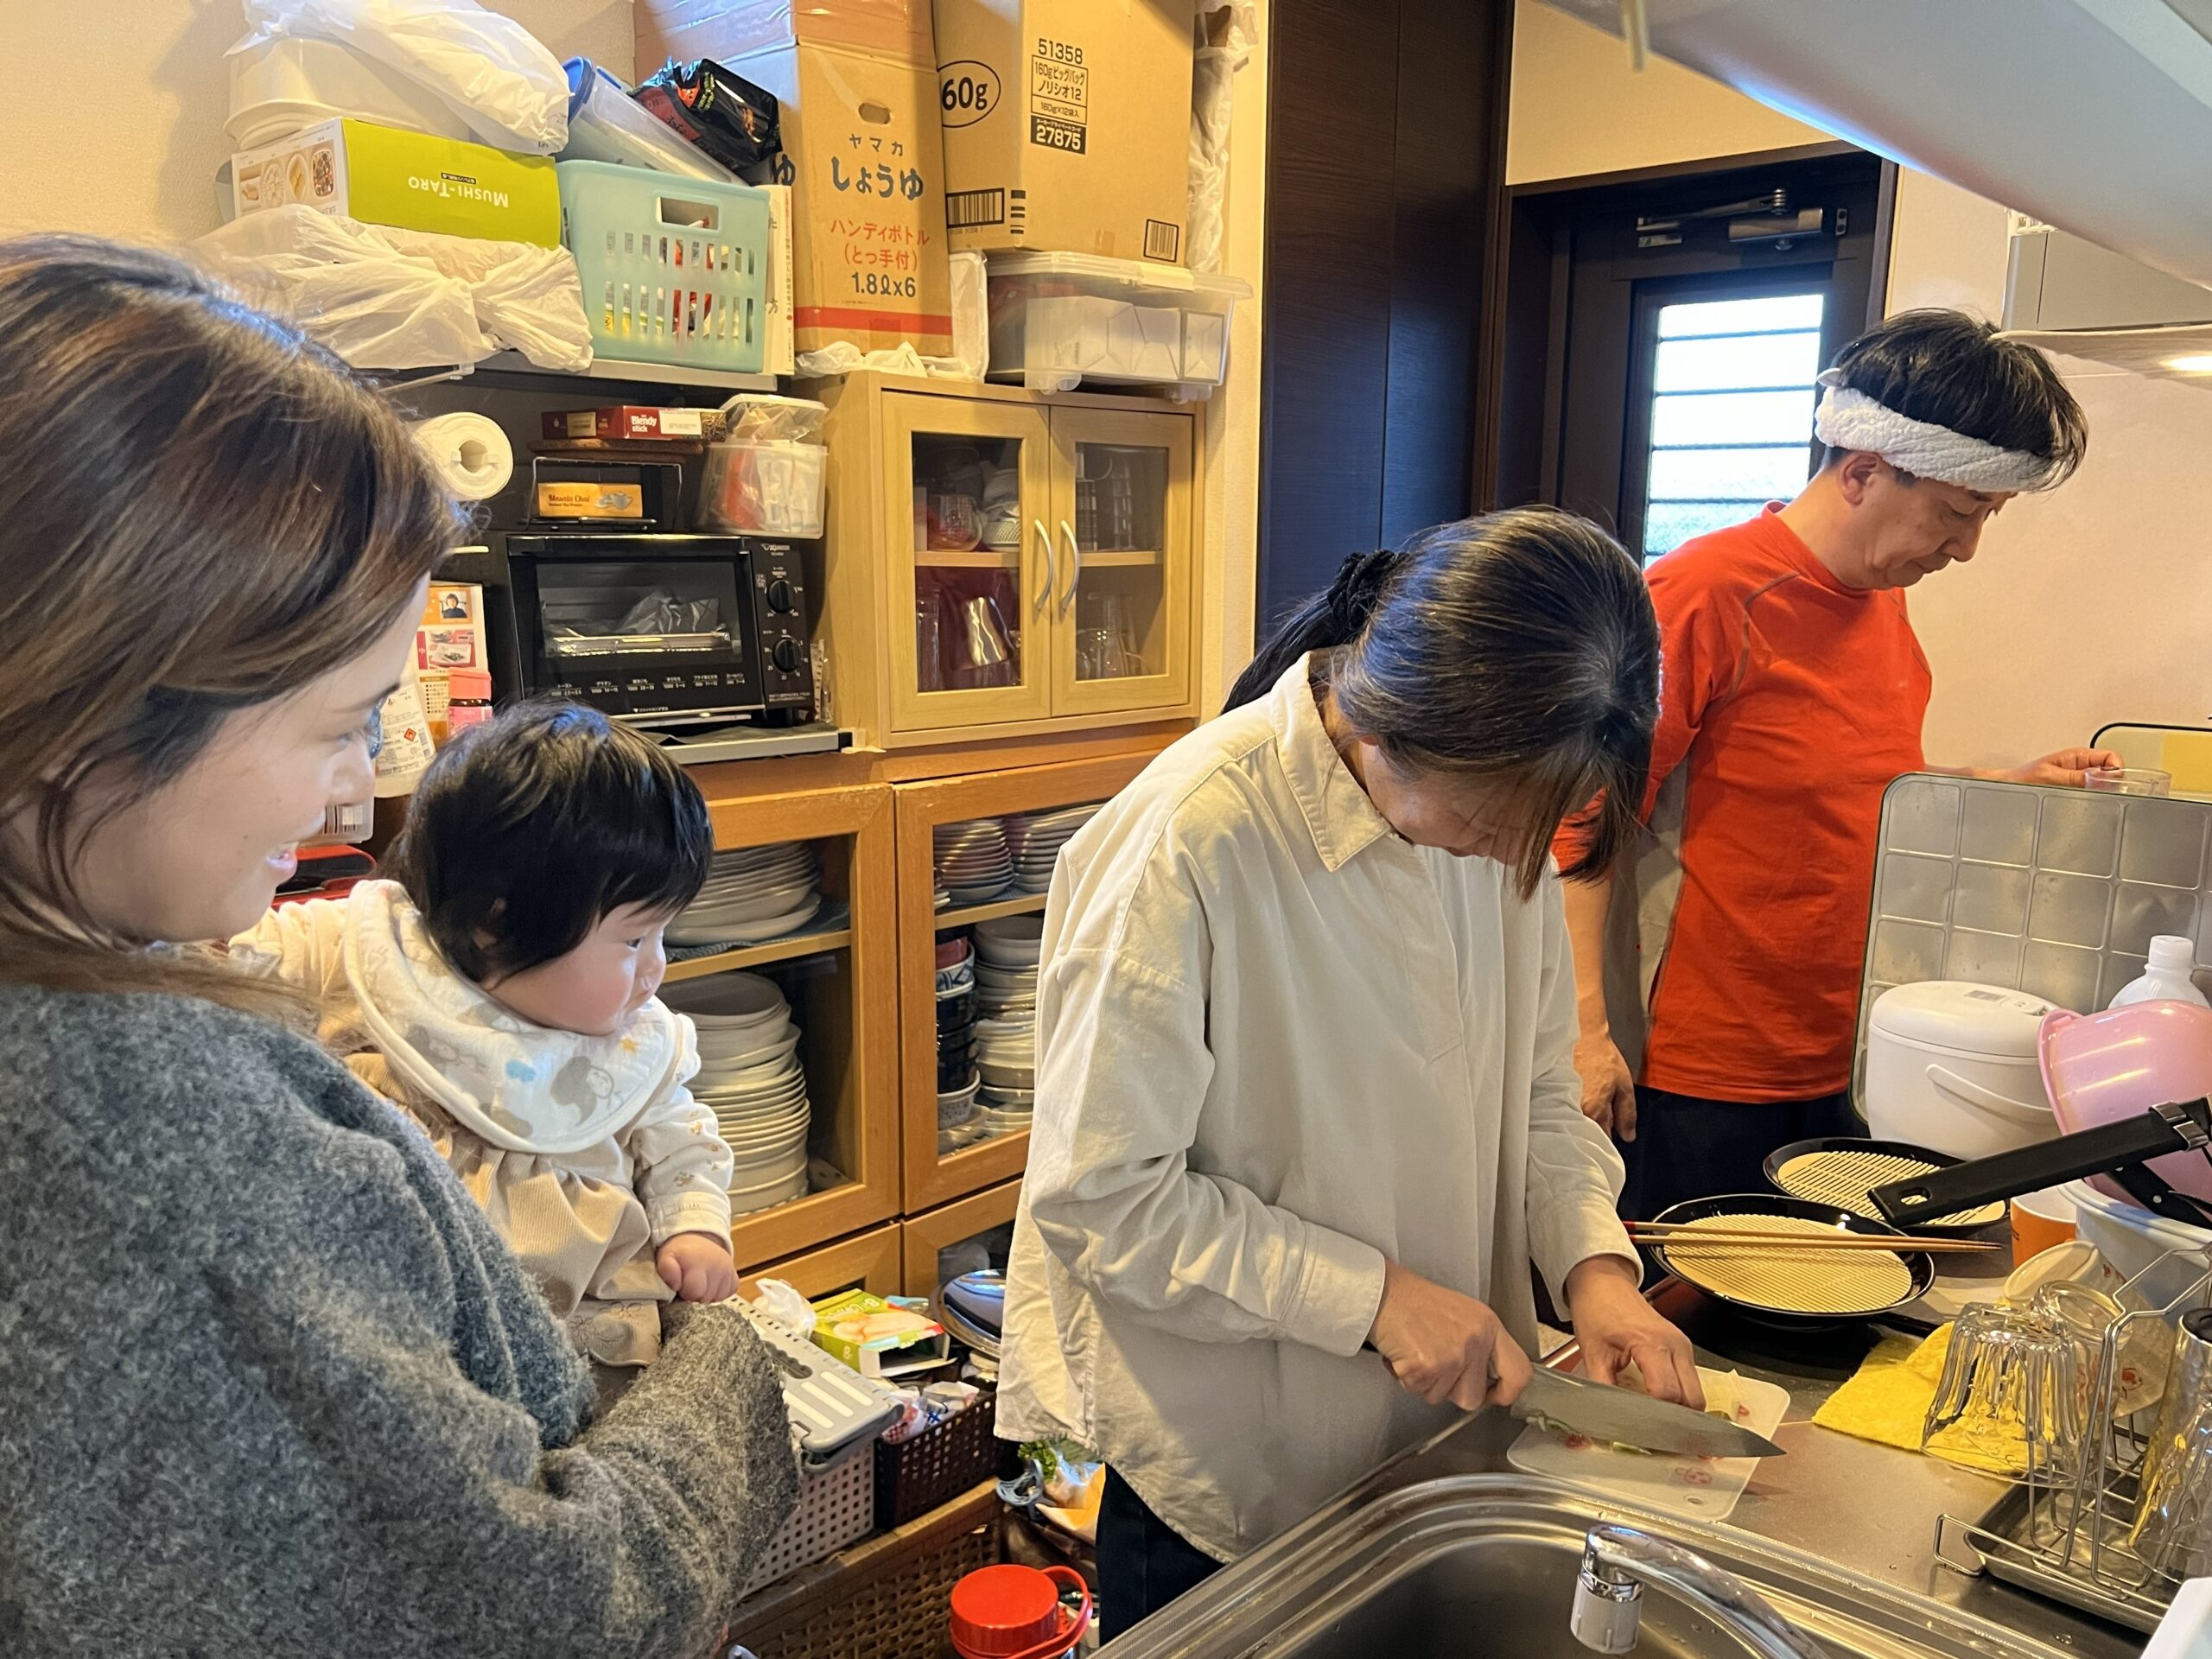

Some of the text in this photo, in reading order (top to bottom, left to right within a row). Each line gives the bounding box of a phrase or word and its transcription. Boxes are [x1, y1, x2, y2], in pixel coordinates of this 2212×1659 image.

[1038, 37, 1084, 65] 51358
[942, 76, 988, 111] 60g
[1038, 79, 1082, 101] ノリシオ12
[849, 133, 904, 157] ヤマカ
[1035, 124, 1082, 150] 27875
[407, 175, 509, 208] MUSHI-TARO
[830, 156, 925, 201] しょうゆ
[830, 219, 931, 246] ハンディボトル
[631, 415, 658, 428] Blendy
